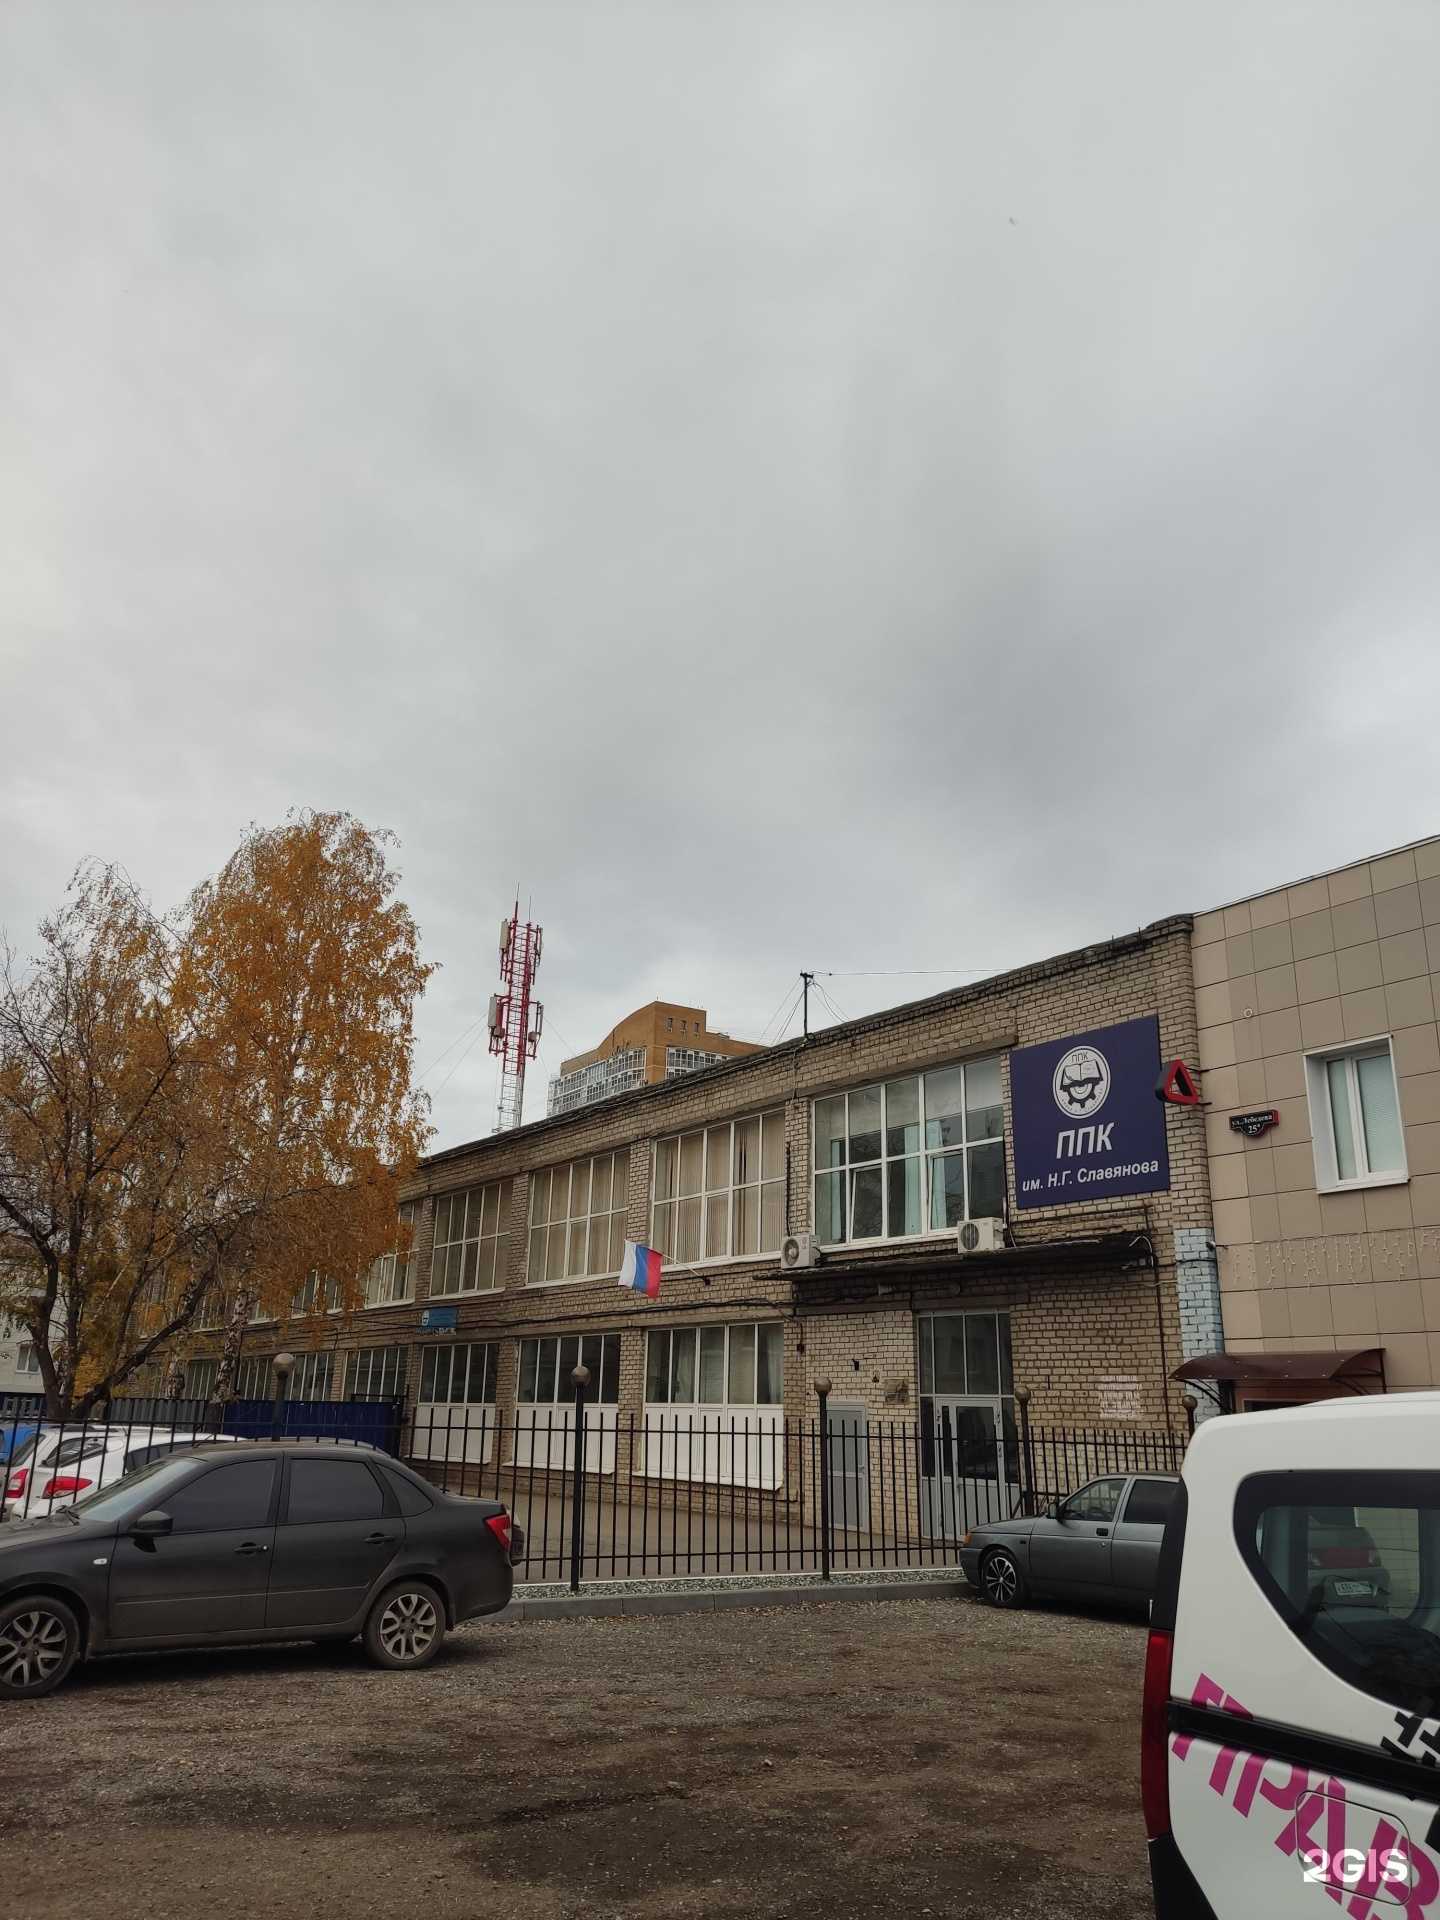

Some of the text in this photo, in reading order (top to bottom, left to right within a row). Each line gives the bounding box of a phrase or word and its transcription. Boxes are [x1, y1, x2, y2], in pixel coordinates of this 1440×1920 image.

[1072, 1052, 1088, 1063] ППК
[1056, 1122, 1114, 1159] ППК
[1022, 1160, 1160, 1192] им. Н.Г. Славянова
